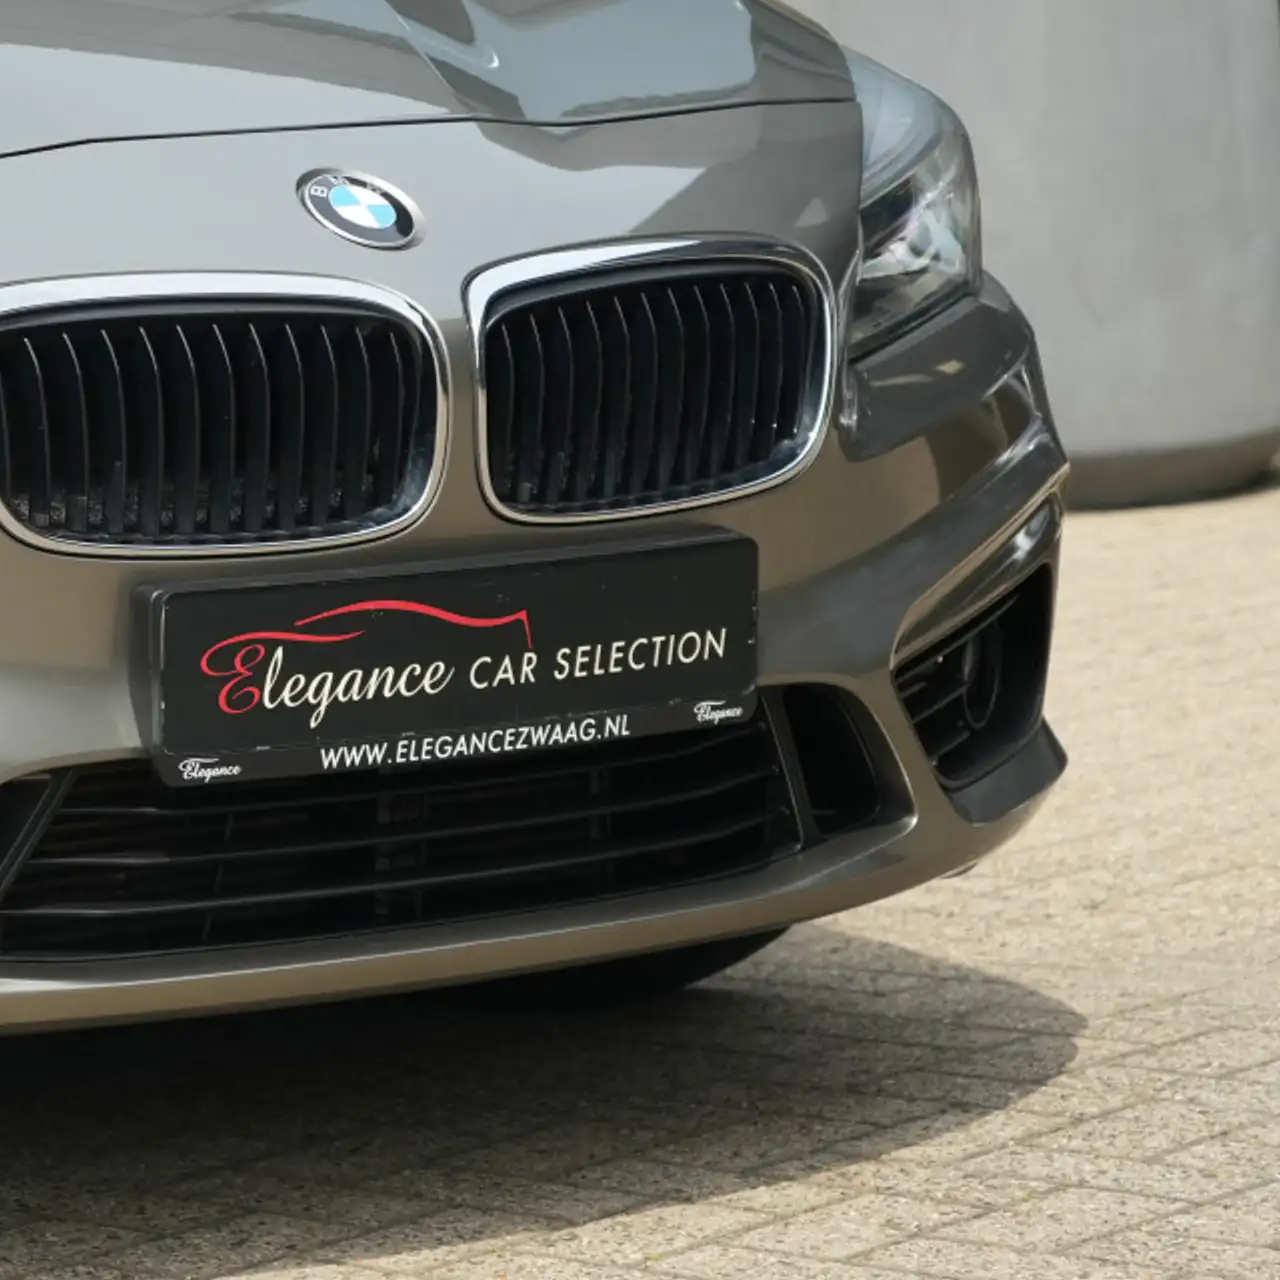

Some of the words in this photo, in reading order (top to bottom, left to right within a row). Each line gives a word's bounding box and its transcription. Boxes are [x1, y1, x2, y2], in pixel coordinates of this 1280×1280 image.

[200, 631, 455, 729] Elegance
[469, 651, 538, 690] CAR
[553, 627, 728, 681] SELECTION
[319, 714, 631, 770] WWW.ELEGANCEZWAAG.NL
